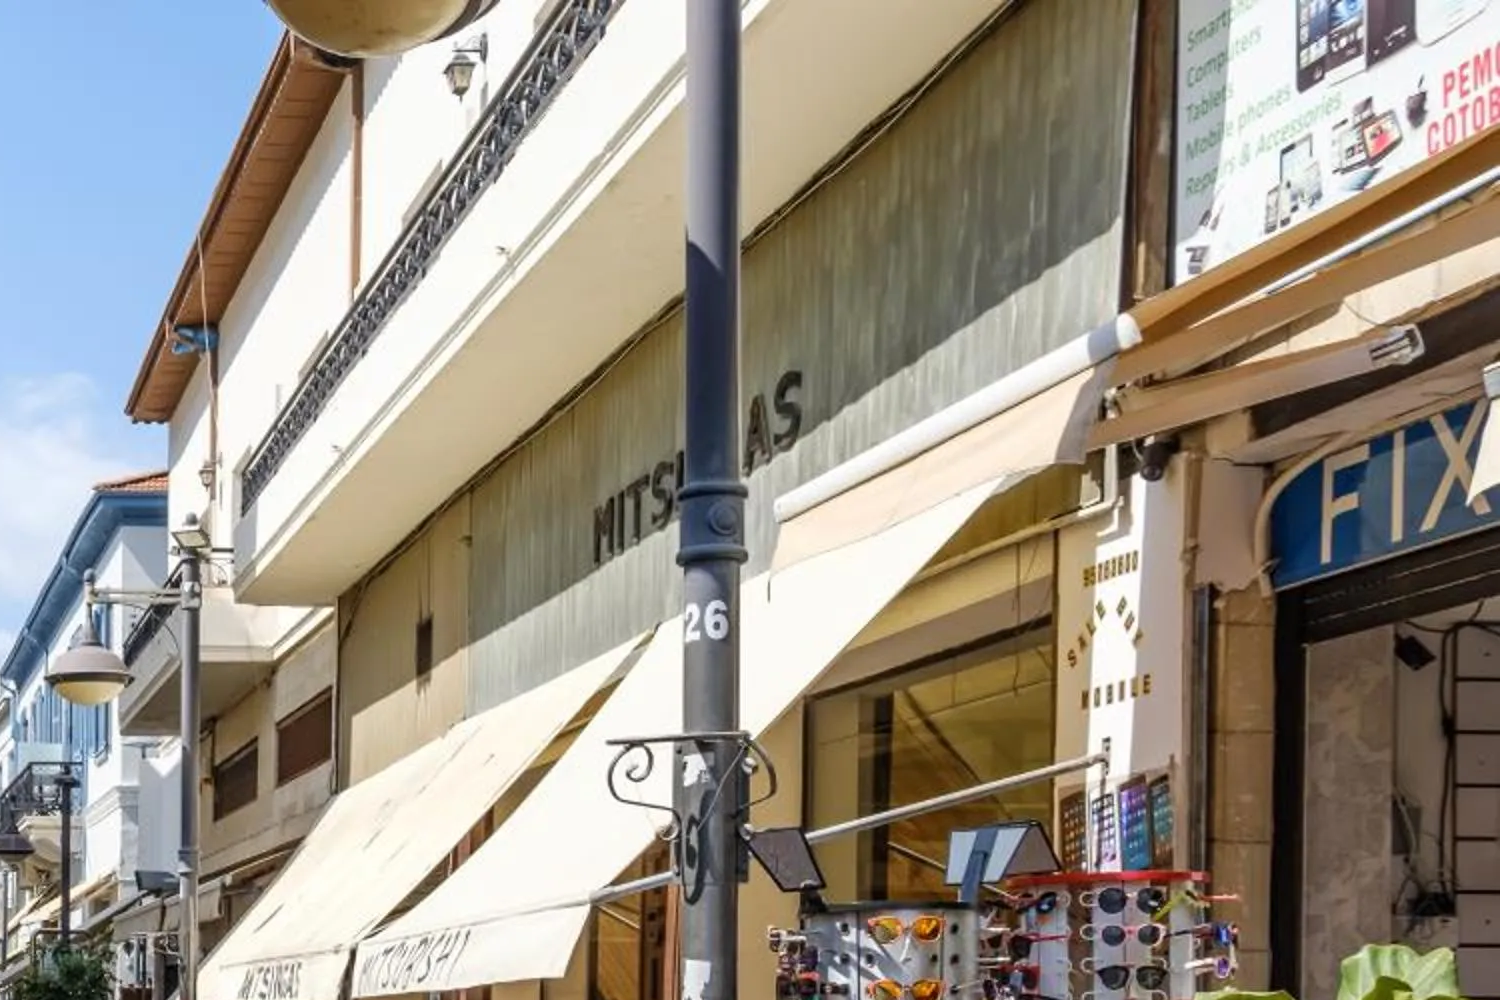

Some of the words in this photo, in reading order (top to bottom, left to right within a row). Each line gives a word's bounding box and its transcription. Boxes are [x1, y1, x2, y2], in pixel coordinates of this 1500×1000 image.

[1185, 120, 1234, 162] Mobile
[1320, 400, 1492, 565] FIX
[685, 599, 730, 644] 26
[1081, 674, 1152, 711] MOBILE
